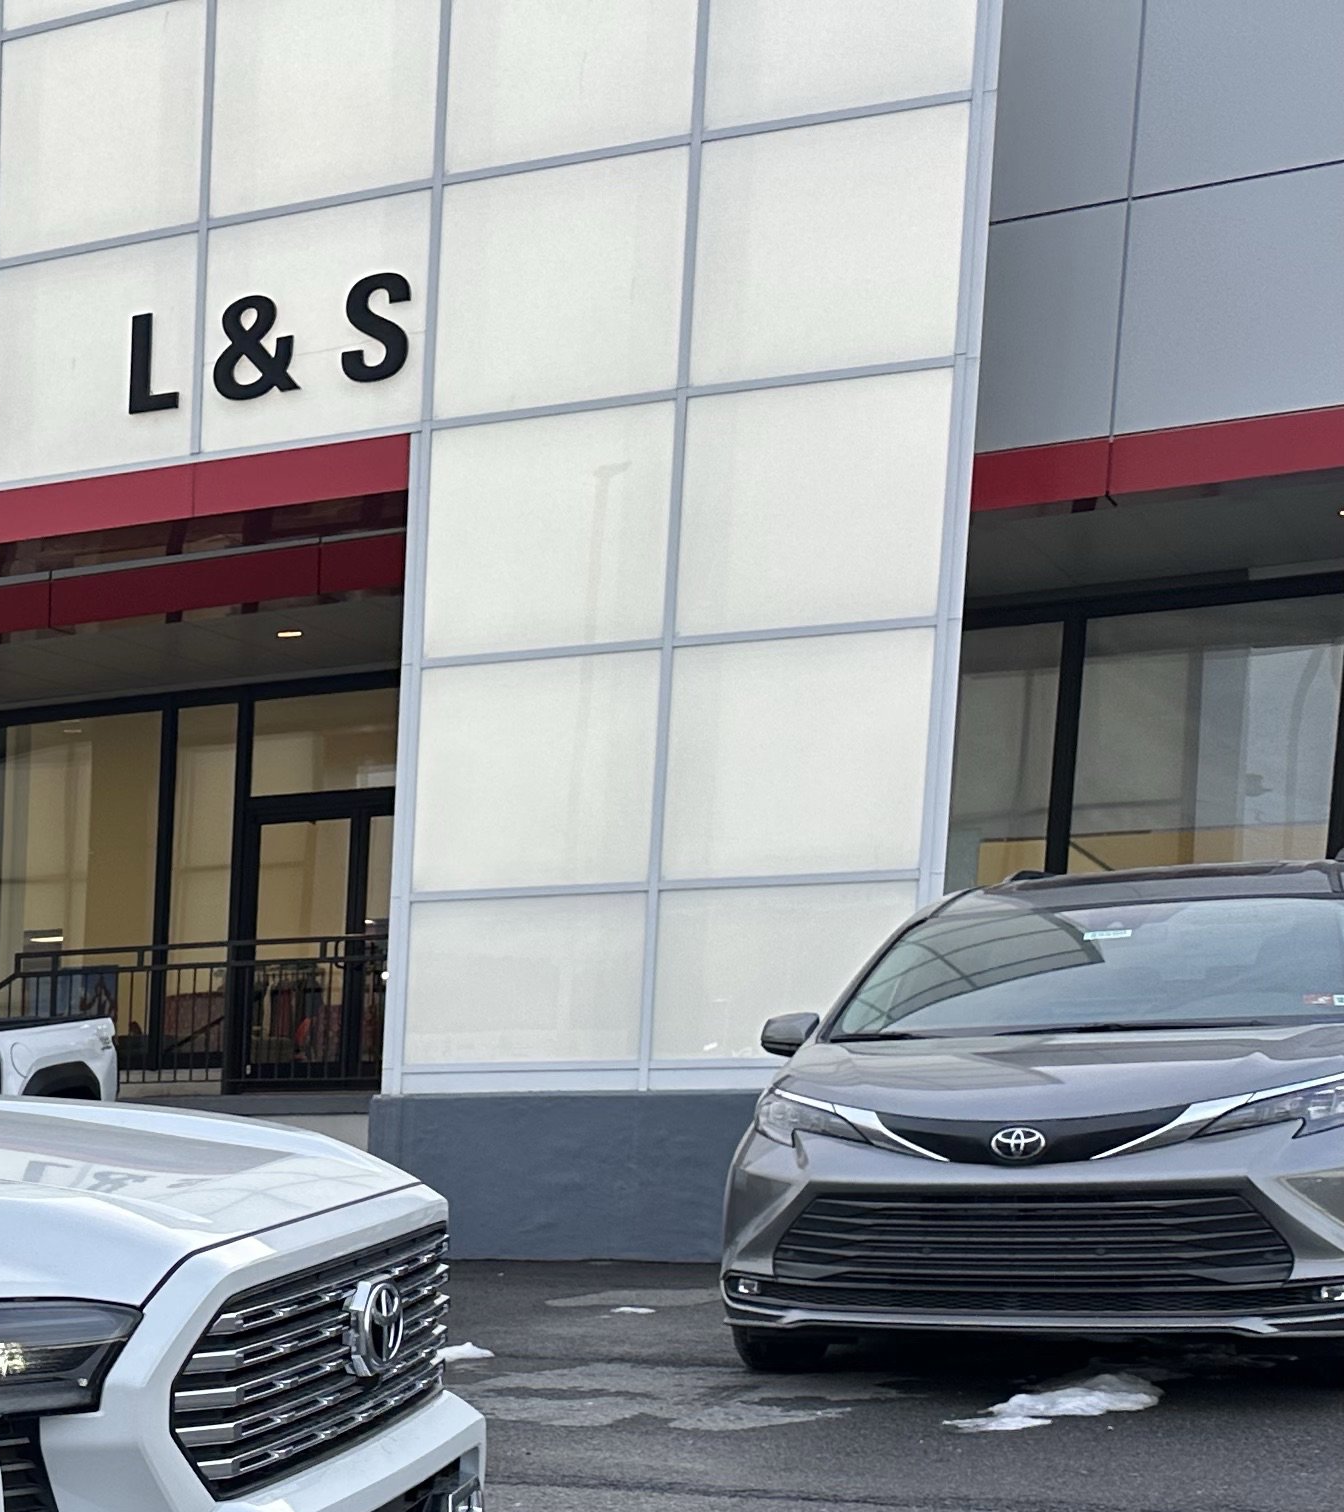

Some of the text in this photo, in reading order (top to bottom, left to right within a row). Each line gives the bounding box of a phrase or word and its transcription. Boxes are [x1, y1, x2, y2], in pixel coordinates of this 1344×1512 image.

[129, 272, 411, 414] L & S
